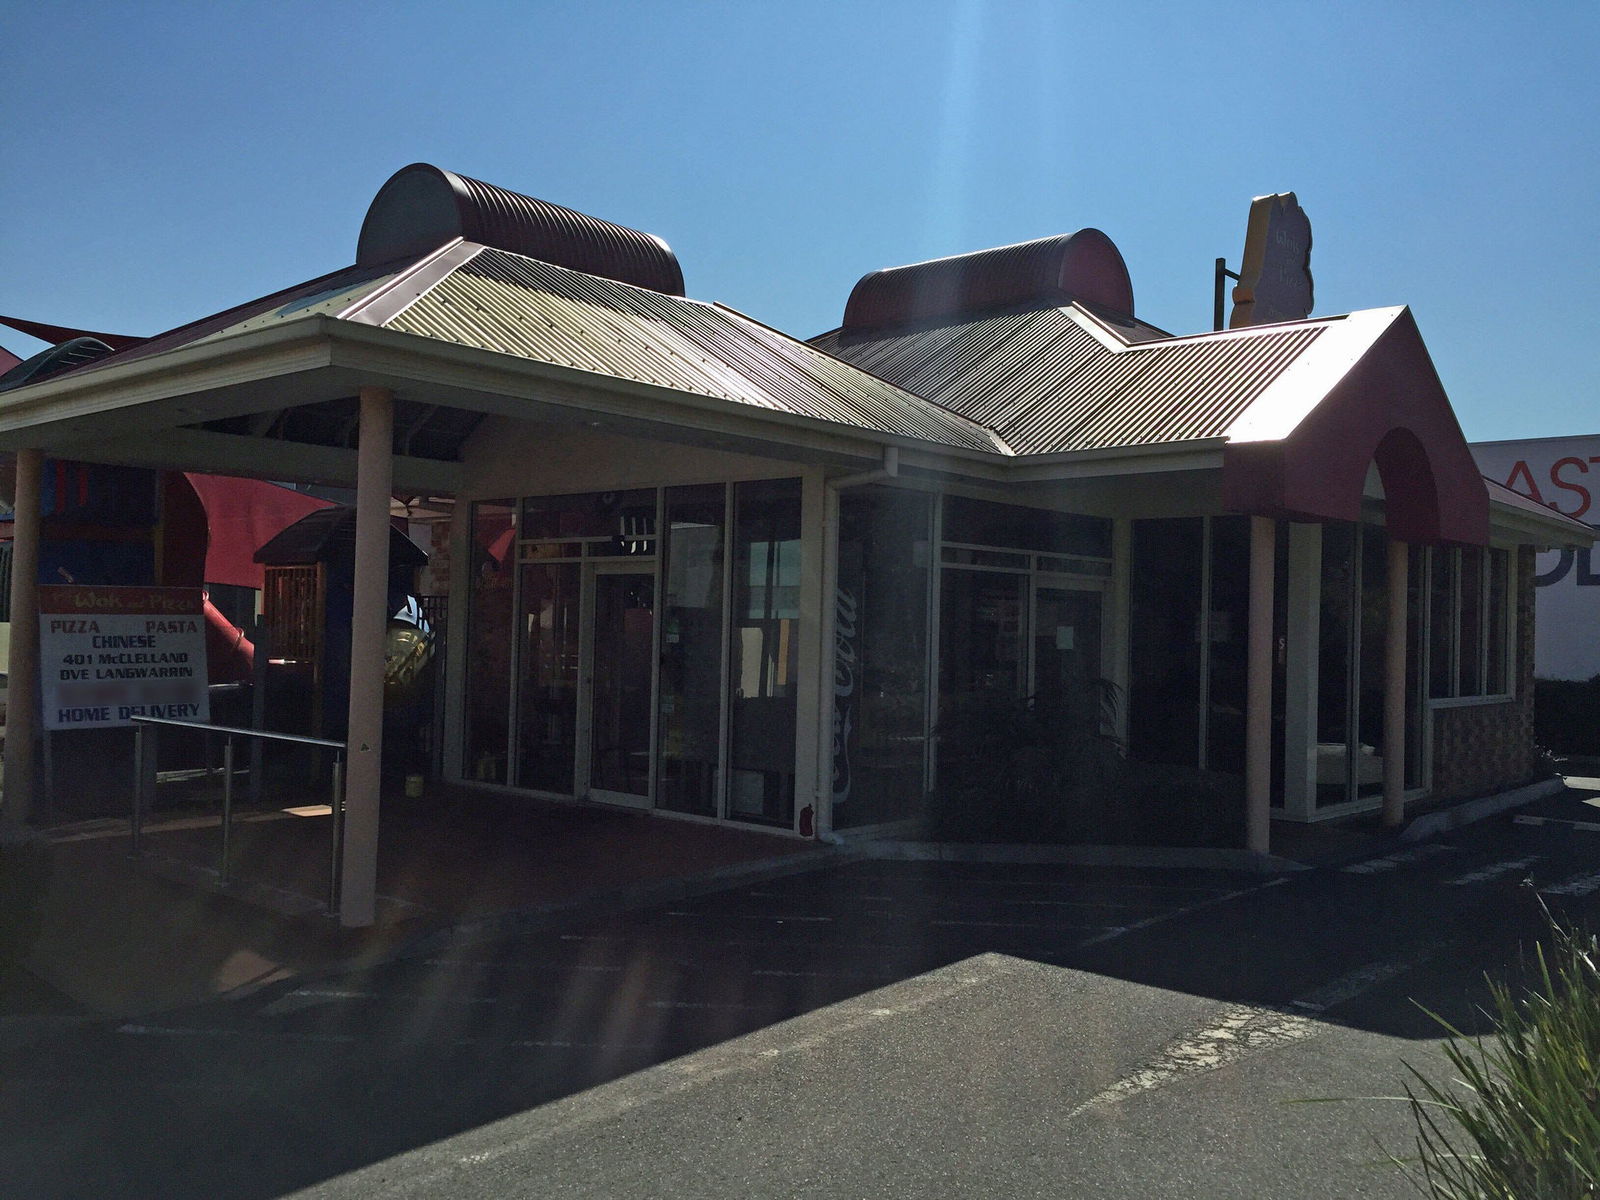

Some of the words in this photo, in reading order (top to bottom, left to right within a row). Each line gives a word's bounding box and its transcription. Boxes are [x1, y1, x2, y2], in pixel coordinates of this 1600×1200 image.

[1505, 457, 1600, 519] AS
[50, 620, 101, 634] PIZZA
[146, 620, 198, 634] PASTA
[92, 635, 157, 649] CHINESE
[63, 654, 94, 665] 401
[99, 652, 188, 665] McCLELLAND
[60, 668, 90, 681] DVE
[96, 666, 193, 680] LANGWARRIN
[58, 706, 111, 724] HOME
[118, 703, 200, 720] DELIVERY
